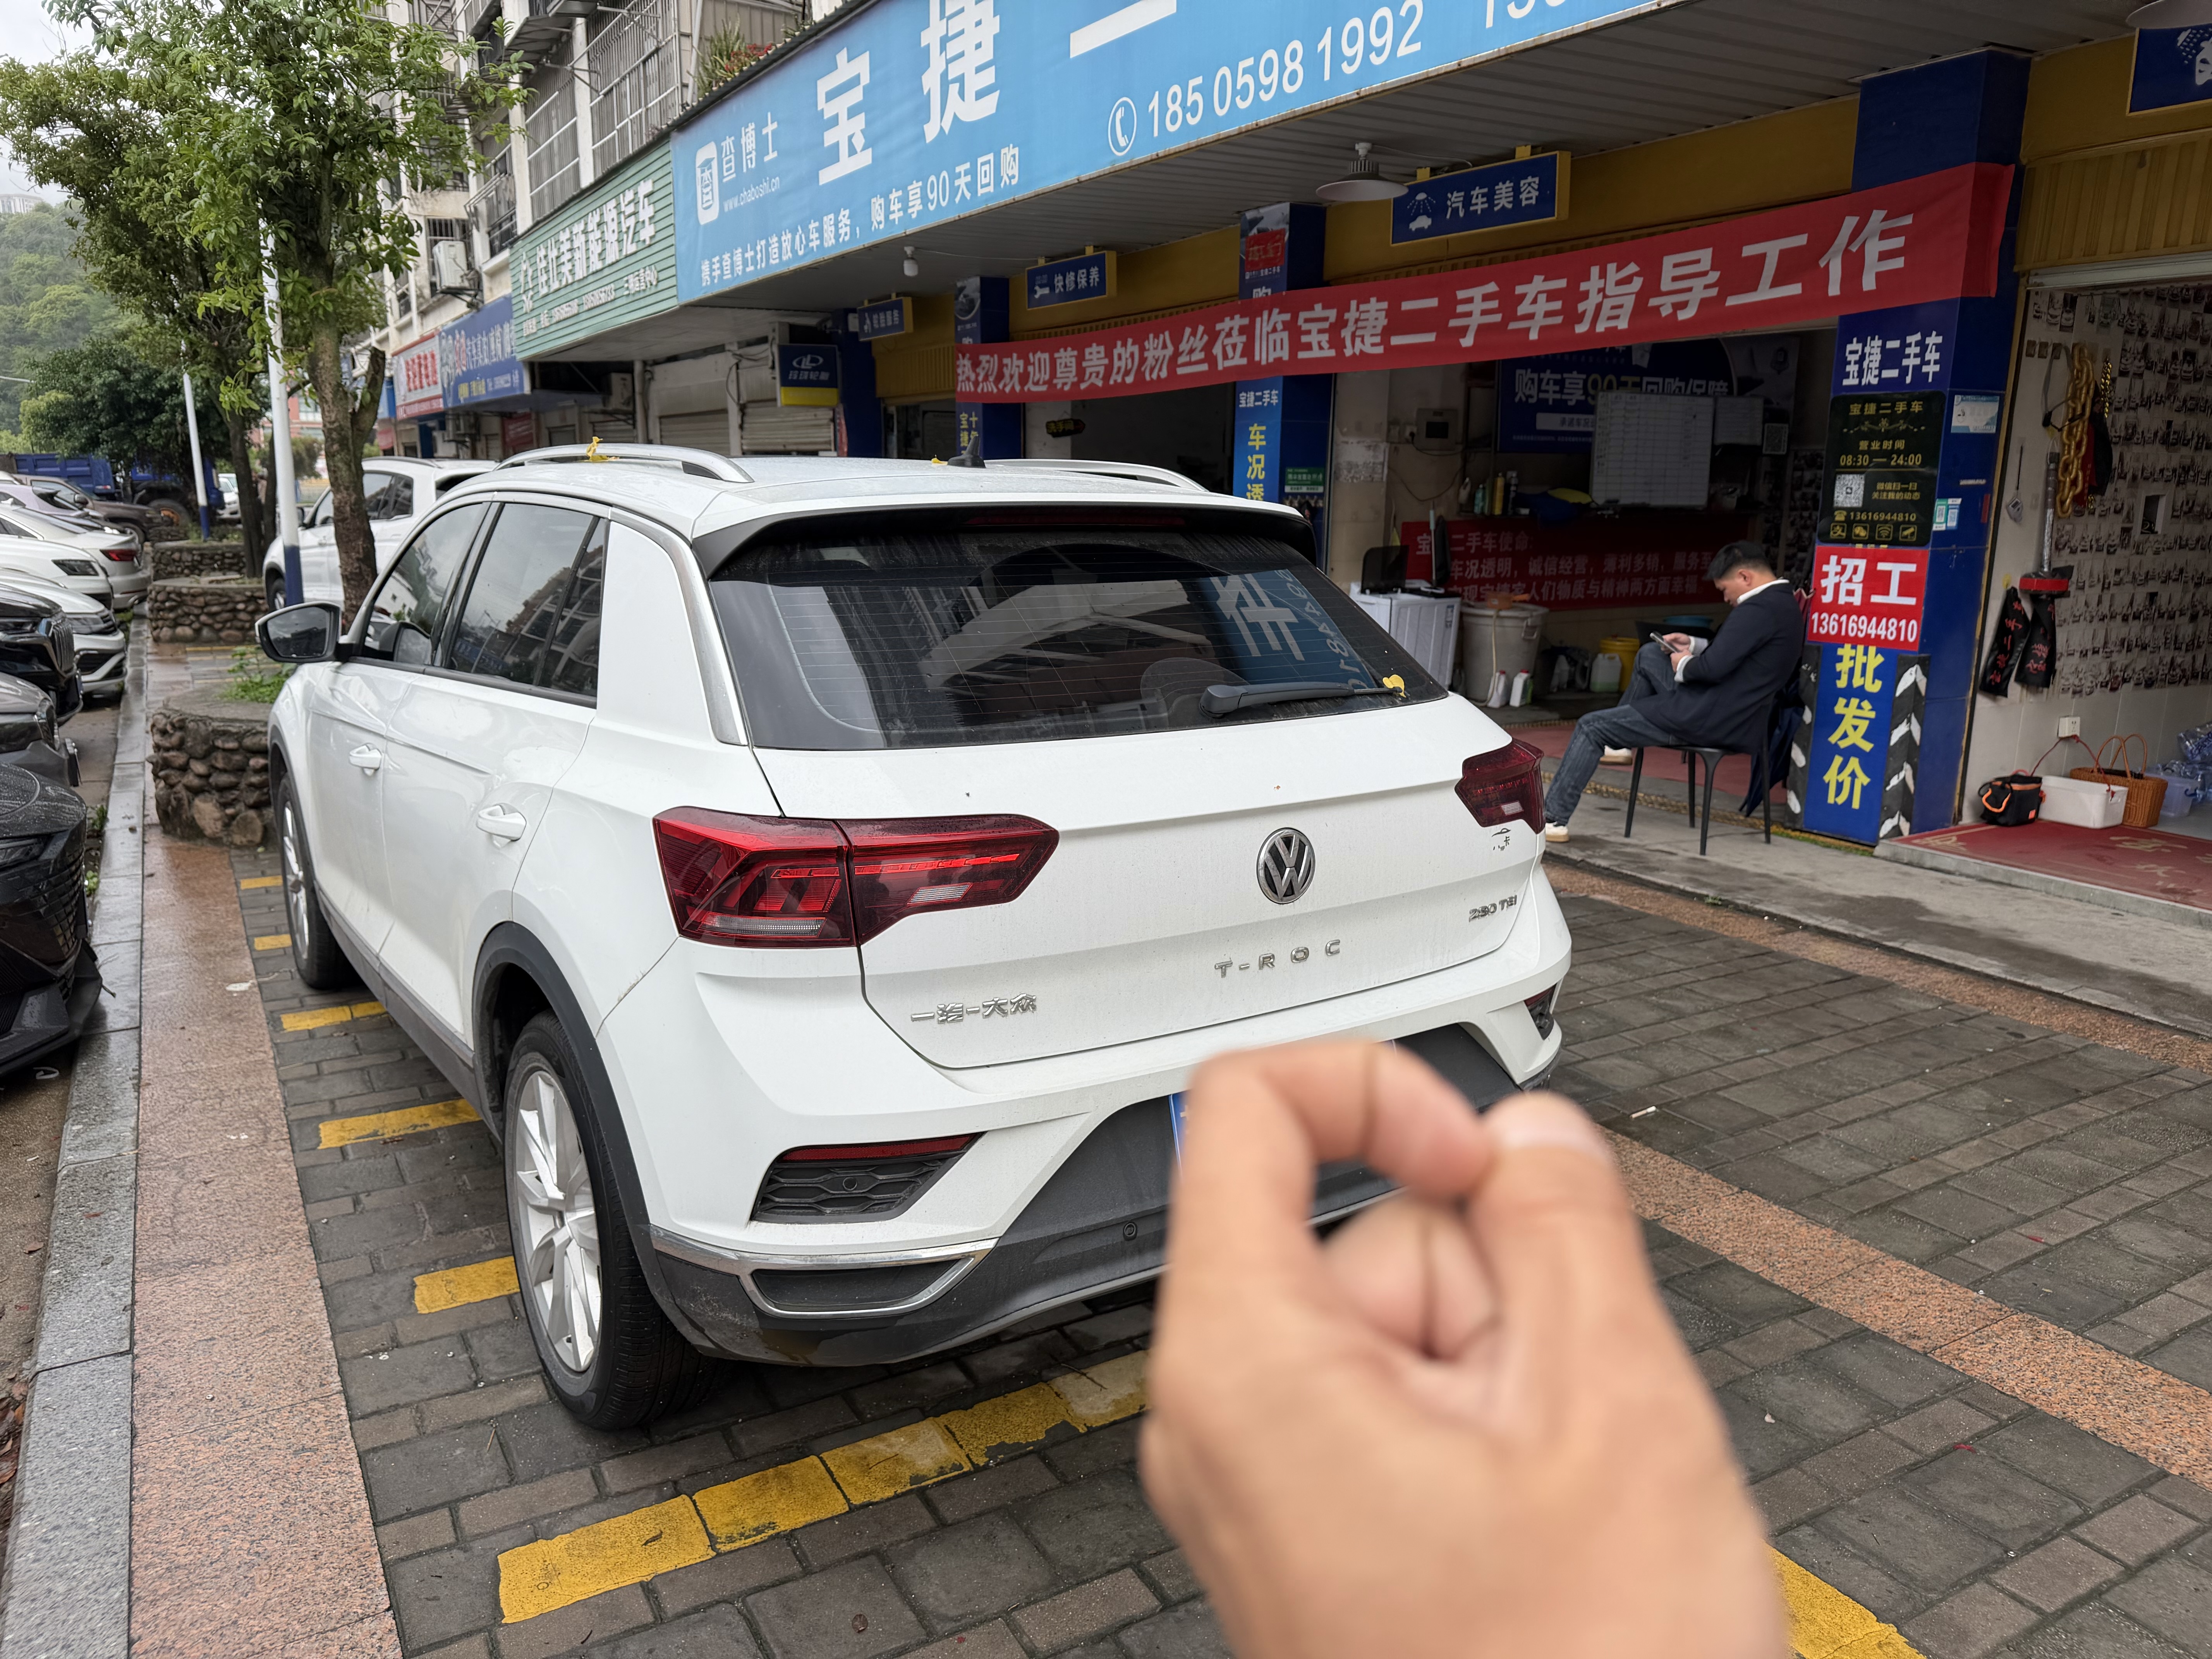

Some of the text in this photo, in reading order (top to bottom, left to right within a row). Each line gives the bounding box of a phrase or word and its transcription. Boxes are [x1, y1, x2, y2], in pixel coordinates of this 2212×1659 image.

[1147, 0, 1422, 137] 185 0598 1992
[721, 112, 778, 183] 查博士
[724, 175, 780, 212] www.chaboshi.cn
[1447, 176, 1540, 218] 汽车美容
[1054, 266, 1100, 294] 快修保养
[956, 209, 1914, 393] 热烈欢迎尊贵的粉丝莅临宝捷二手车指导工作
[1843, 331, 1943, 386] 宝捷二手车
[1239, 390, 1278, 407] 宝捷二手车
[1849, 400, 1923, 416] 宝捷二手车
[1840, 454, 1869, 466] 08:30
[1891, 453, 1922, 465] 24:00
[1859, 440, 1905, 451] 营业时间
[1872, 491, 1921, 501] 关注我的动态
[1877, 482, 1917, 491] 微信扫一扫
[1850, 511, 1917, 522] 13616944810
[1821, 554, 1917, 606] 招工
[1811, 613, 1917, 642] 13616944810
[1823, 643, 1885, 809] 批发价
[911, 993, 1037, 1025] 一汽-大众
